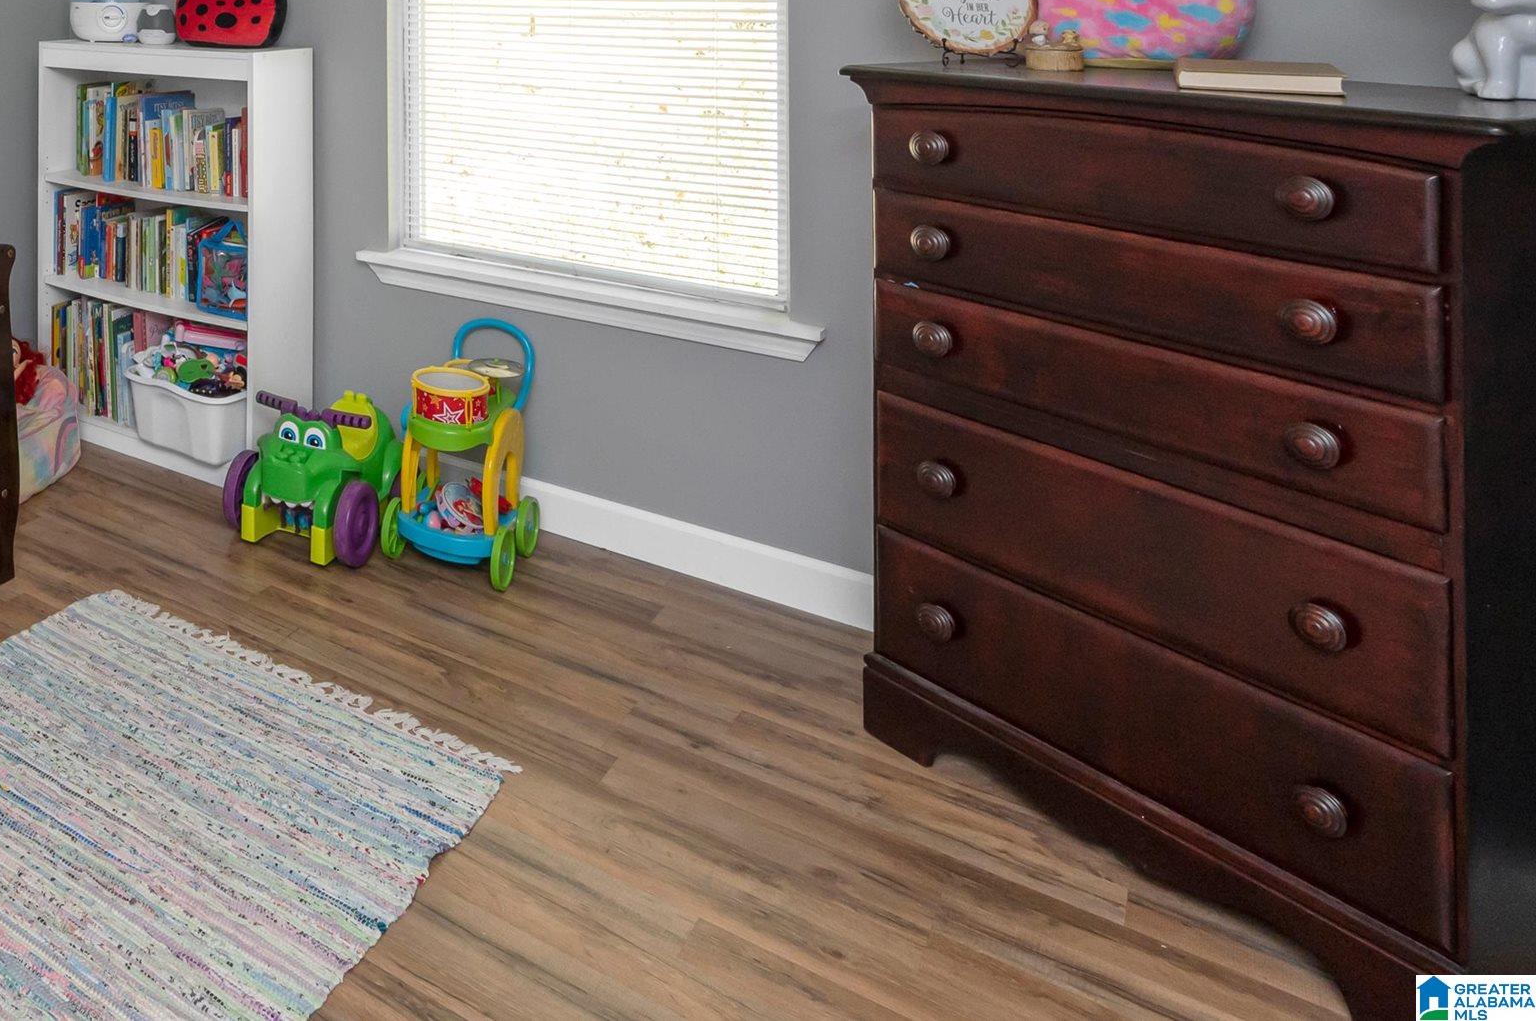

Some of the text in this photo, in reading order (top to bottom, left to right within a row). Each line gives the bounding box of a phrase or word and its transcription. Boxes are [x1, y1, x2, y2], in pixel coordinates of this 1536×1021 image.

[966, 2, 990, 12] IN HER
[942, 5, 999, 25] Heart
